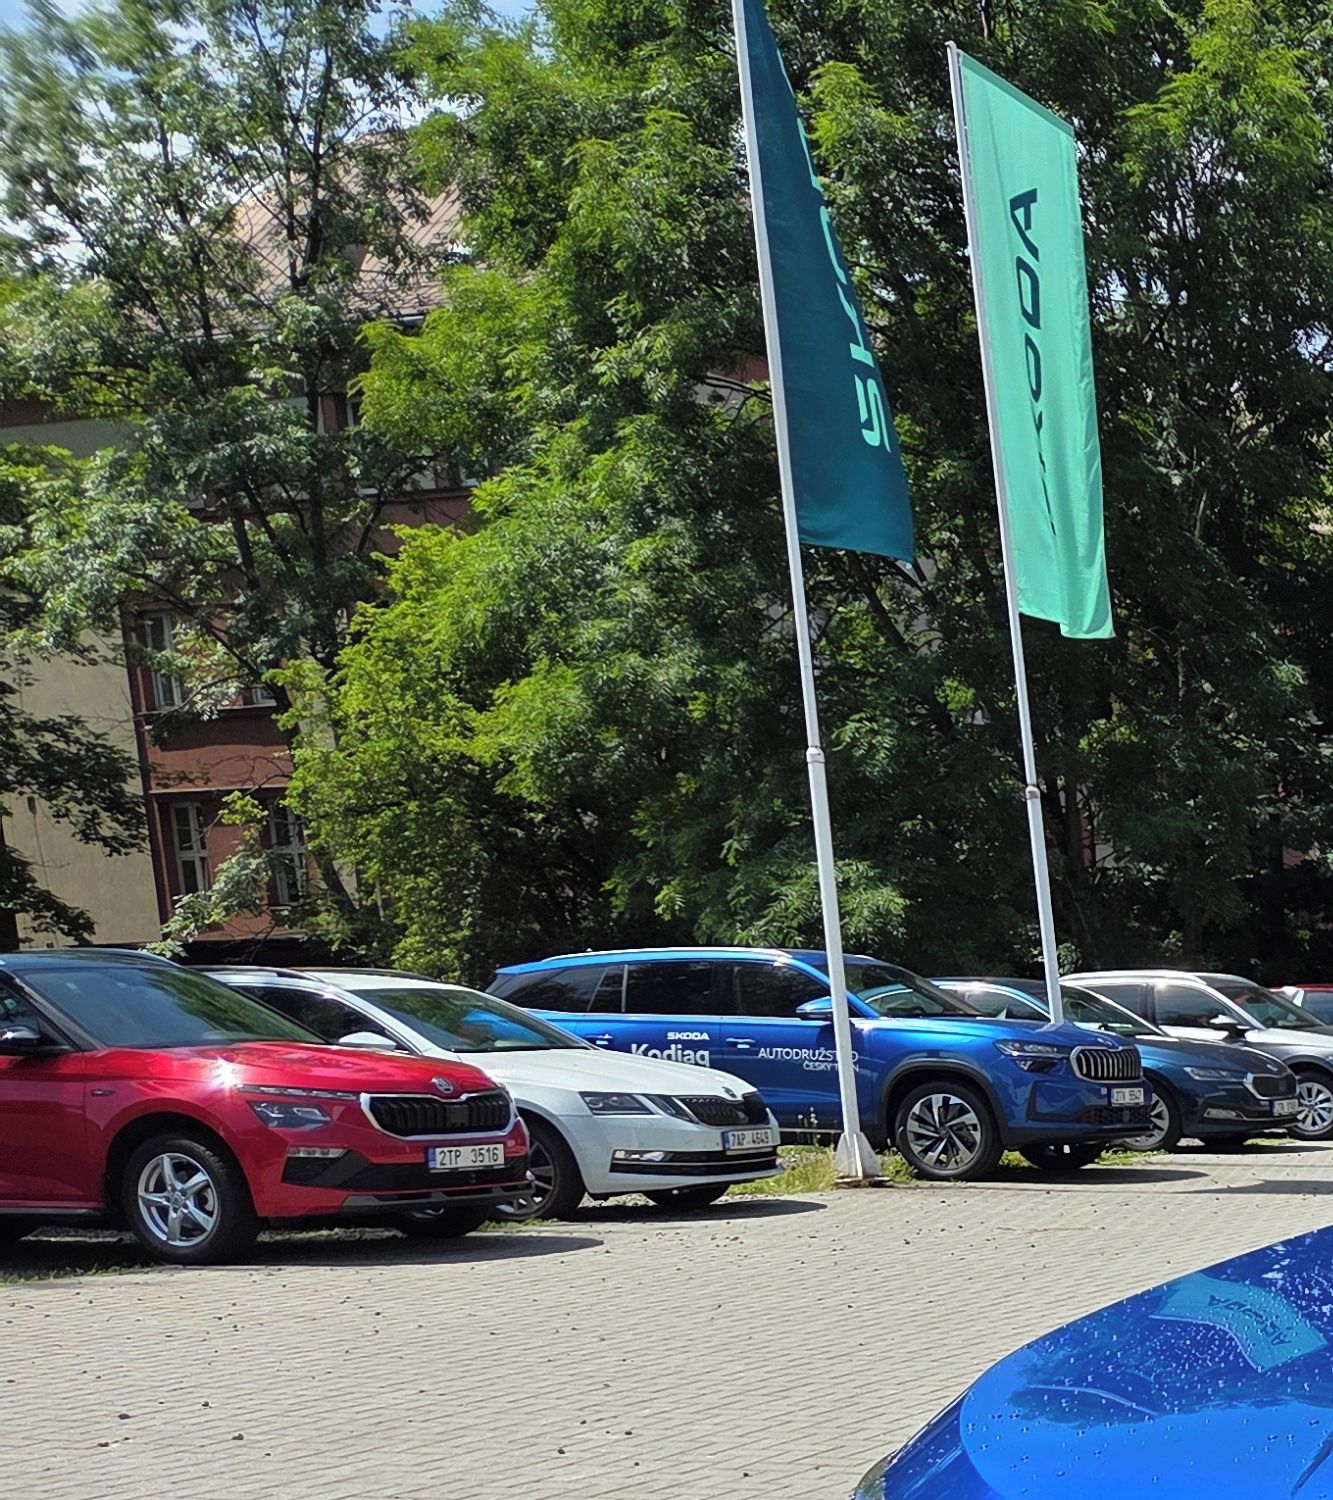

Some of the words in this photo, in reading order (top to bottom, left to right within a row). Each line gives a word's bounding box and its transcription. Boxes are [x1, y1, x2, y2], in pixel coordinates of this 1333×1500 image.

[758, 1046, 859, 1062] AUTODRUŽSO
[439, 1149, 461, 1166] 2TP
[470, 1147, 499, 1163] 3516
